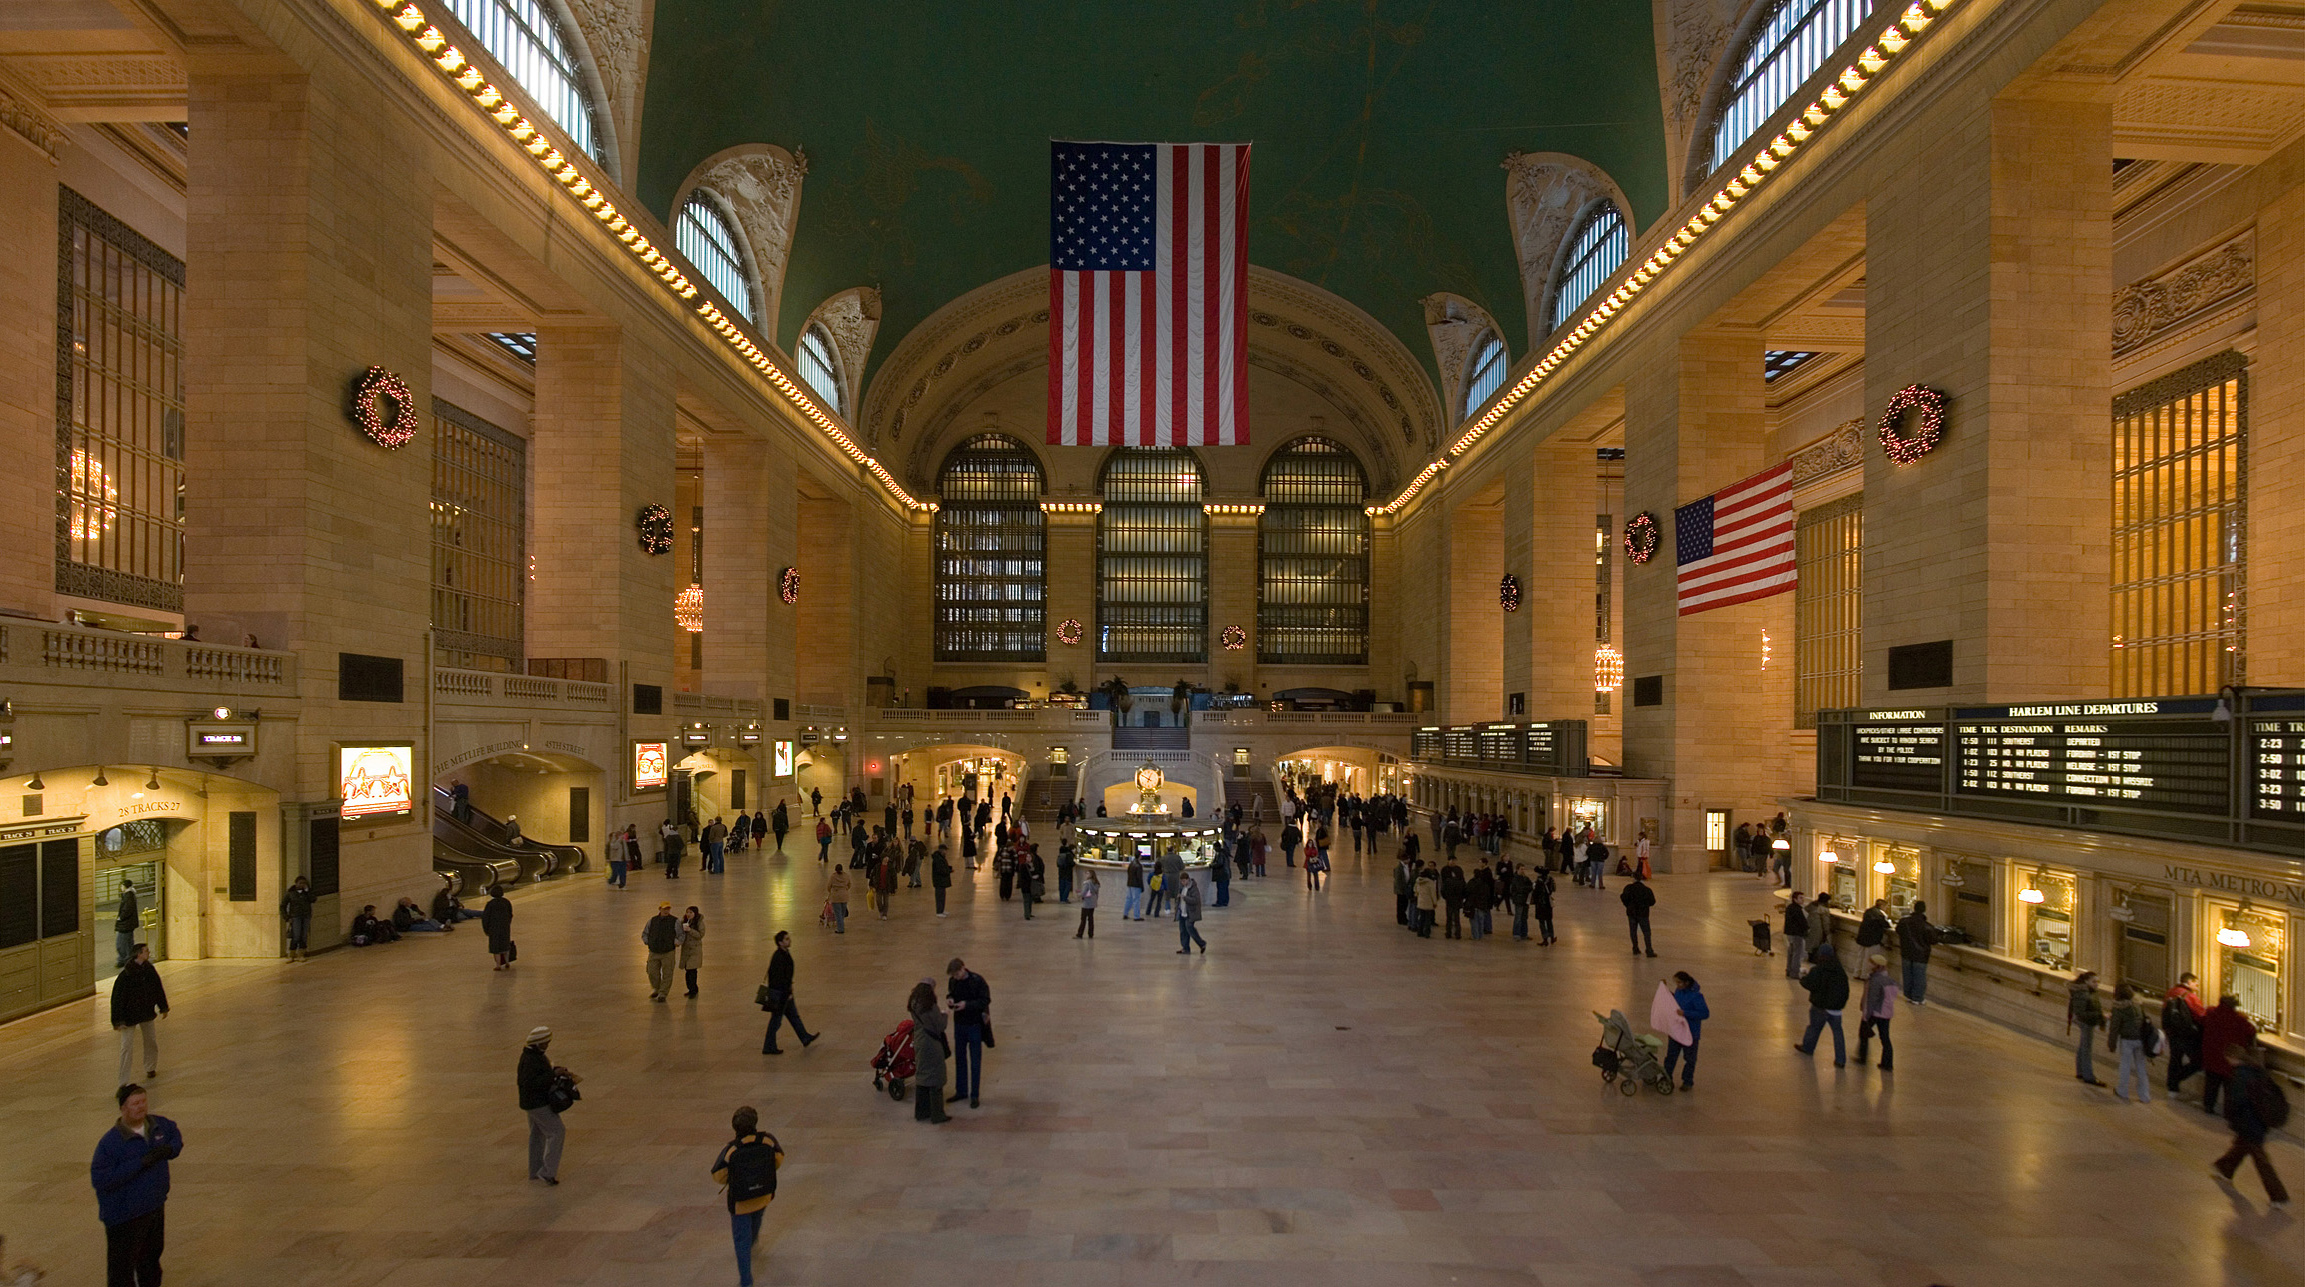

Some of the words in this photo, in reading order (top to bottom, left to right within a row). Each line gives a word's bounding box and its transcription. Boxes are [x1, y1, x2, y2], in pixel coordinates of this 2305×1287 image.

[1870, 710, 1926, 720] INFORMATION
[2009, 706, 2052, 717] HARLEM
[2054, 705, 2081, 716] LINE
[2084, 702, 2158, 714] DEPARTURES
[1959, 726, 1978, 734] TIME
[1981, 726, 1998, 734] TRK
[2064, 725, 2108, 733] REMARKS
[2253, 722, 2281, 732] TIME
[545, 740, 561, 750] 45TH
[562, 742, 585, 756] STREET
[2002, 738, 2034, 746] SOUTHEAST
[2066, 738, 2100, 746] DEPARTED
[2260, 738, 2282, 748] 2:23
[450, 746, 486, 766] METLIFE
[486, 740, 522, 754] BUILDING
[1964, 748, 1978, 756] 1:02
[1987, 748, 1998, 756] 103
[2026, 750, 2050, 758] PLAINS
[2108, 750, 2120, 759] 1ST
[2122, 751, 2142, 760] STOP
[2260, 754, 2282, 764] 2:50
[2002, 760, 2013, 768] NO.
[2026, 760, 2050, 768] PLAINS
[2066, 762, 2096, 771] MELROSE
[2108, 763, 2120, 772] 1ST
[2122, 764, 2142, 772] STOP
[1986, 770, 1998, 778] 112
[2002, 771, 2034, 780] SOUTHEAST
[2066, 774, 2109, 784] CONNECTION
[2112, 776, 2120, 784] TO
[2260, 768, 2282, 779] 3:02
[1962, 780, 1978, 788] 2:02
[2002, 782, 2013, 790] NO.
[2026, 784, 2050, 792] PLAINS
[2107, 788, 2120, 797] 1ST
[2122, 790, 2142, 798] STOP
[2260, 784, 2282, 794] 3:23
[118, 806, 129, 818] 28
[130, 801, 168, 815] TRACKS
[170, 802, 181, 812] 27
[2260, 798, 2282, 810] 3:50
[2164, 864, 2202, 884] MTA
